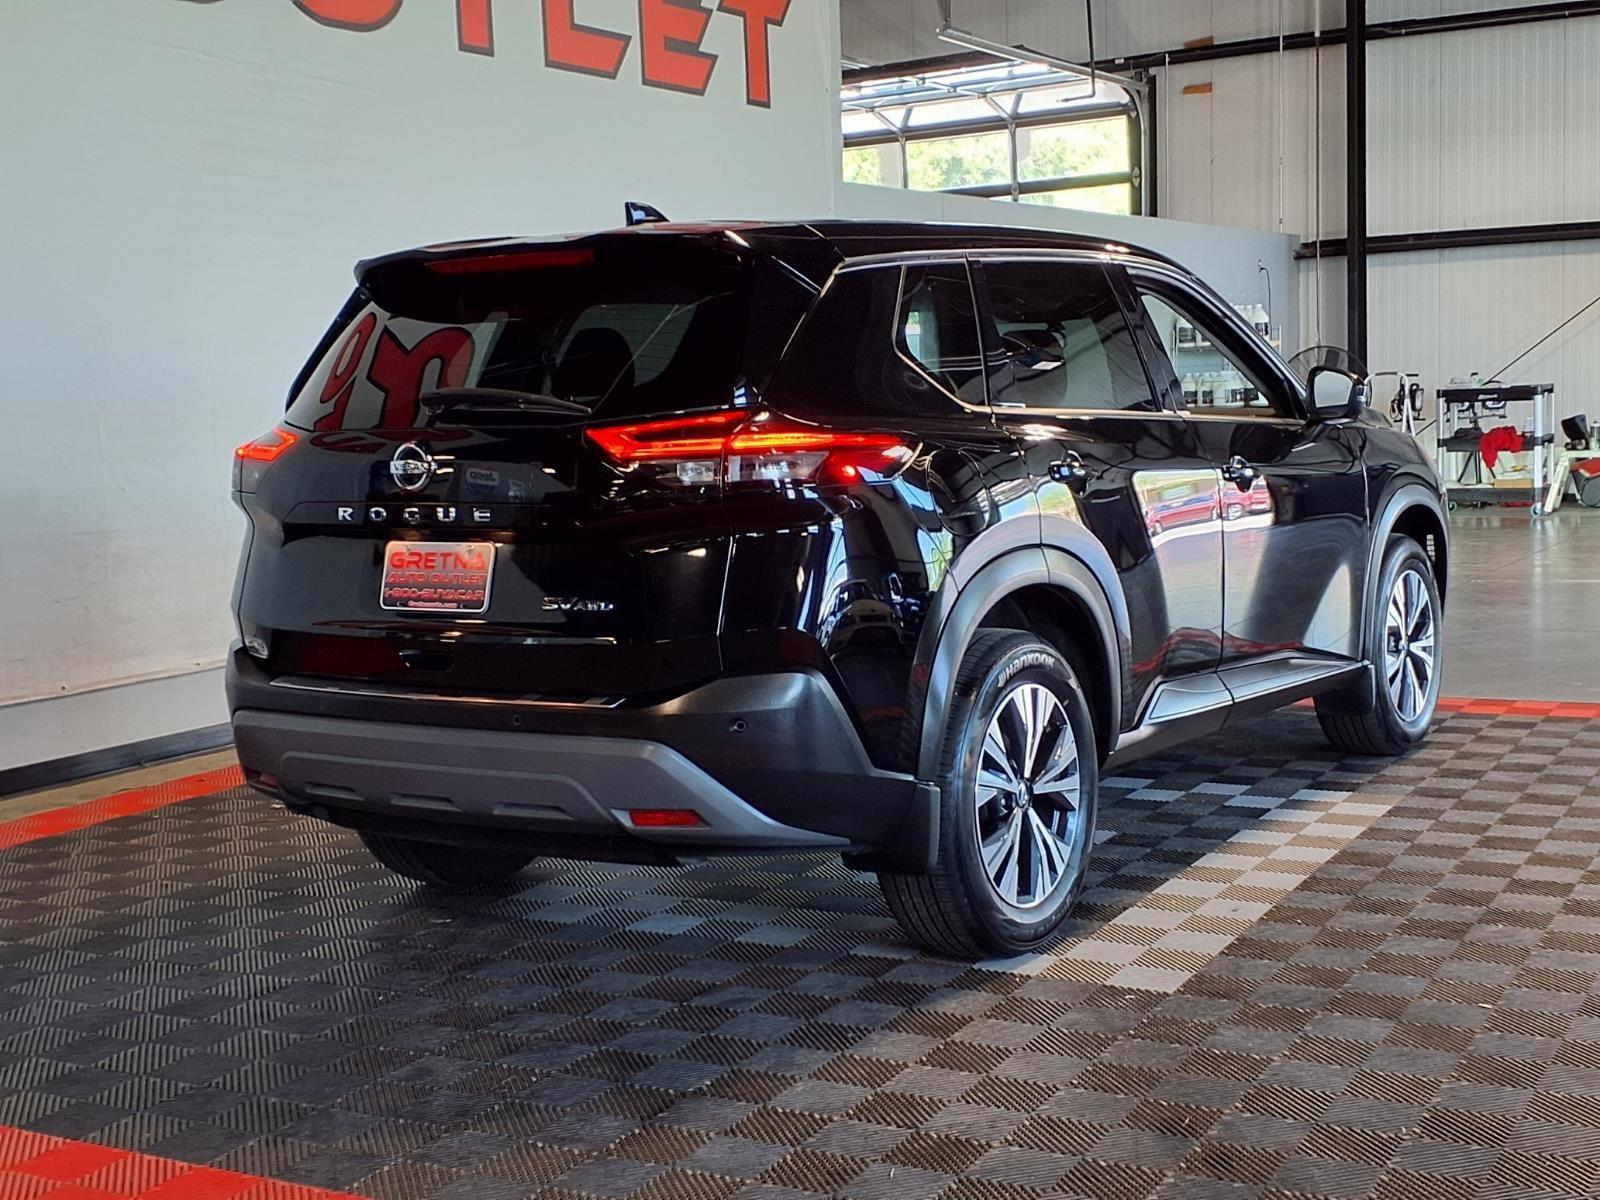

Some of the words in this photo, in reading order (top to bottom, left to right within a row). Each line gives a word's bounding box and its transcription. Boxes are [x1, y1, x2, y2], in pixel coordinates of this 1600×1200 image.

[176, 0, 790, 108] LET
[337, 507, 491, 525] ROGUE
[389, 551, 486, 571] GRETNA
[386, 572, 426, 585] AUTO
[430, 572, 487, 587] OUTLET
[541, 597, 578, 610] SV
